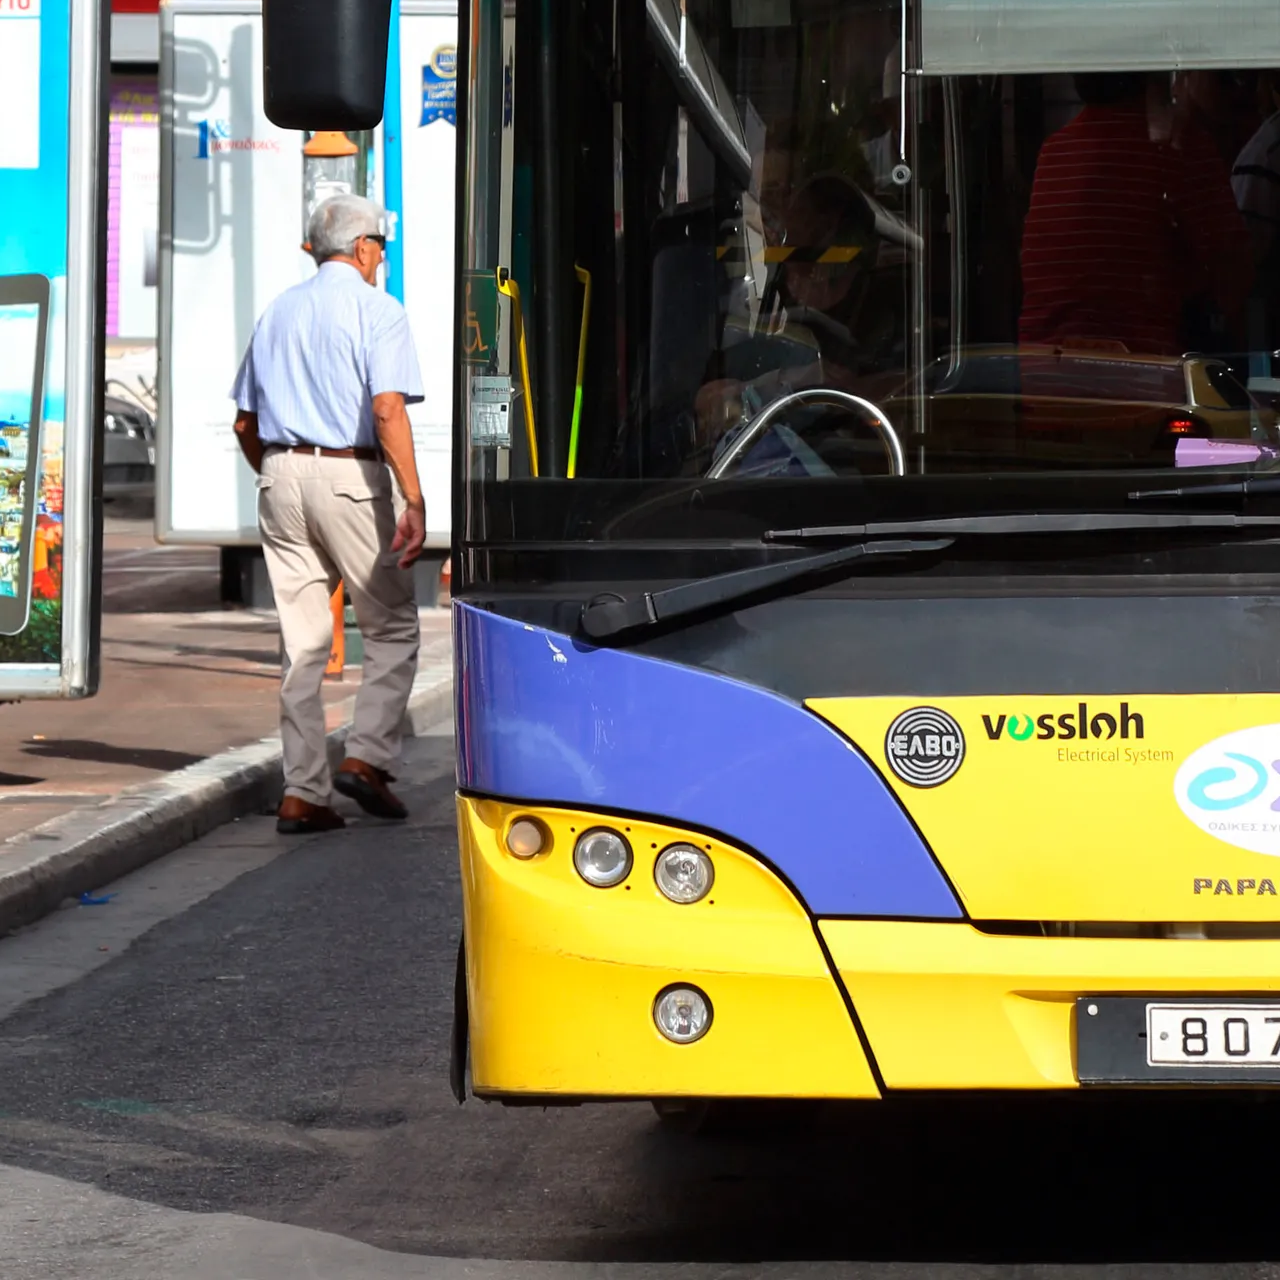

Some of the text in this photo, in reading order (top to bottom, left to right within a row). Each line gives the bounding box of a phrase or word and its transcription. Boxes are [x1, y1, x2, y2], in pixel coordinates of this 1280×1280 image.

[981, 702, 1144, 741] vossloh
[1057, 747, 1174, 764] Electrical System
[1208, 822, 1258, 832] ΟΔΙΚΕΣ
